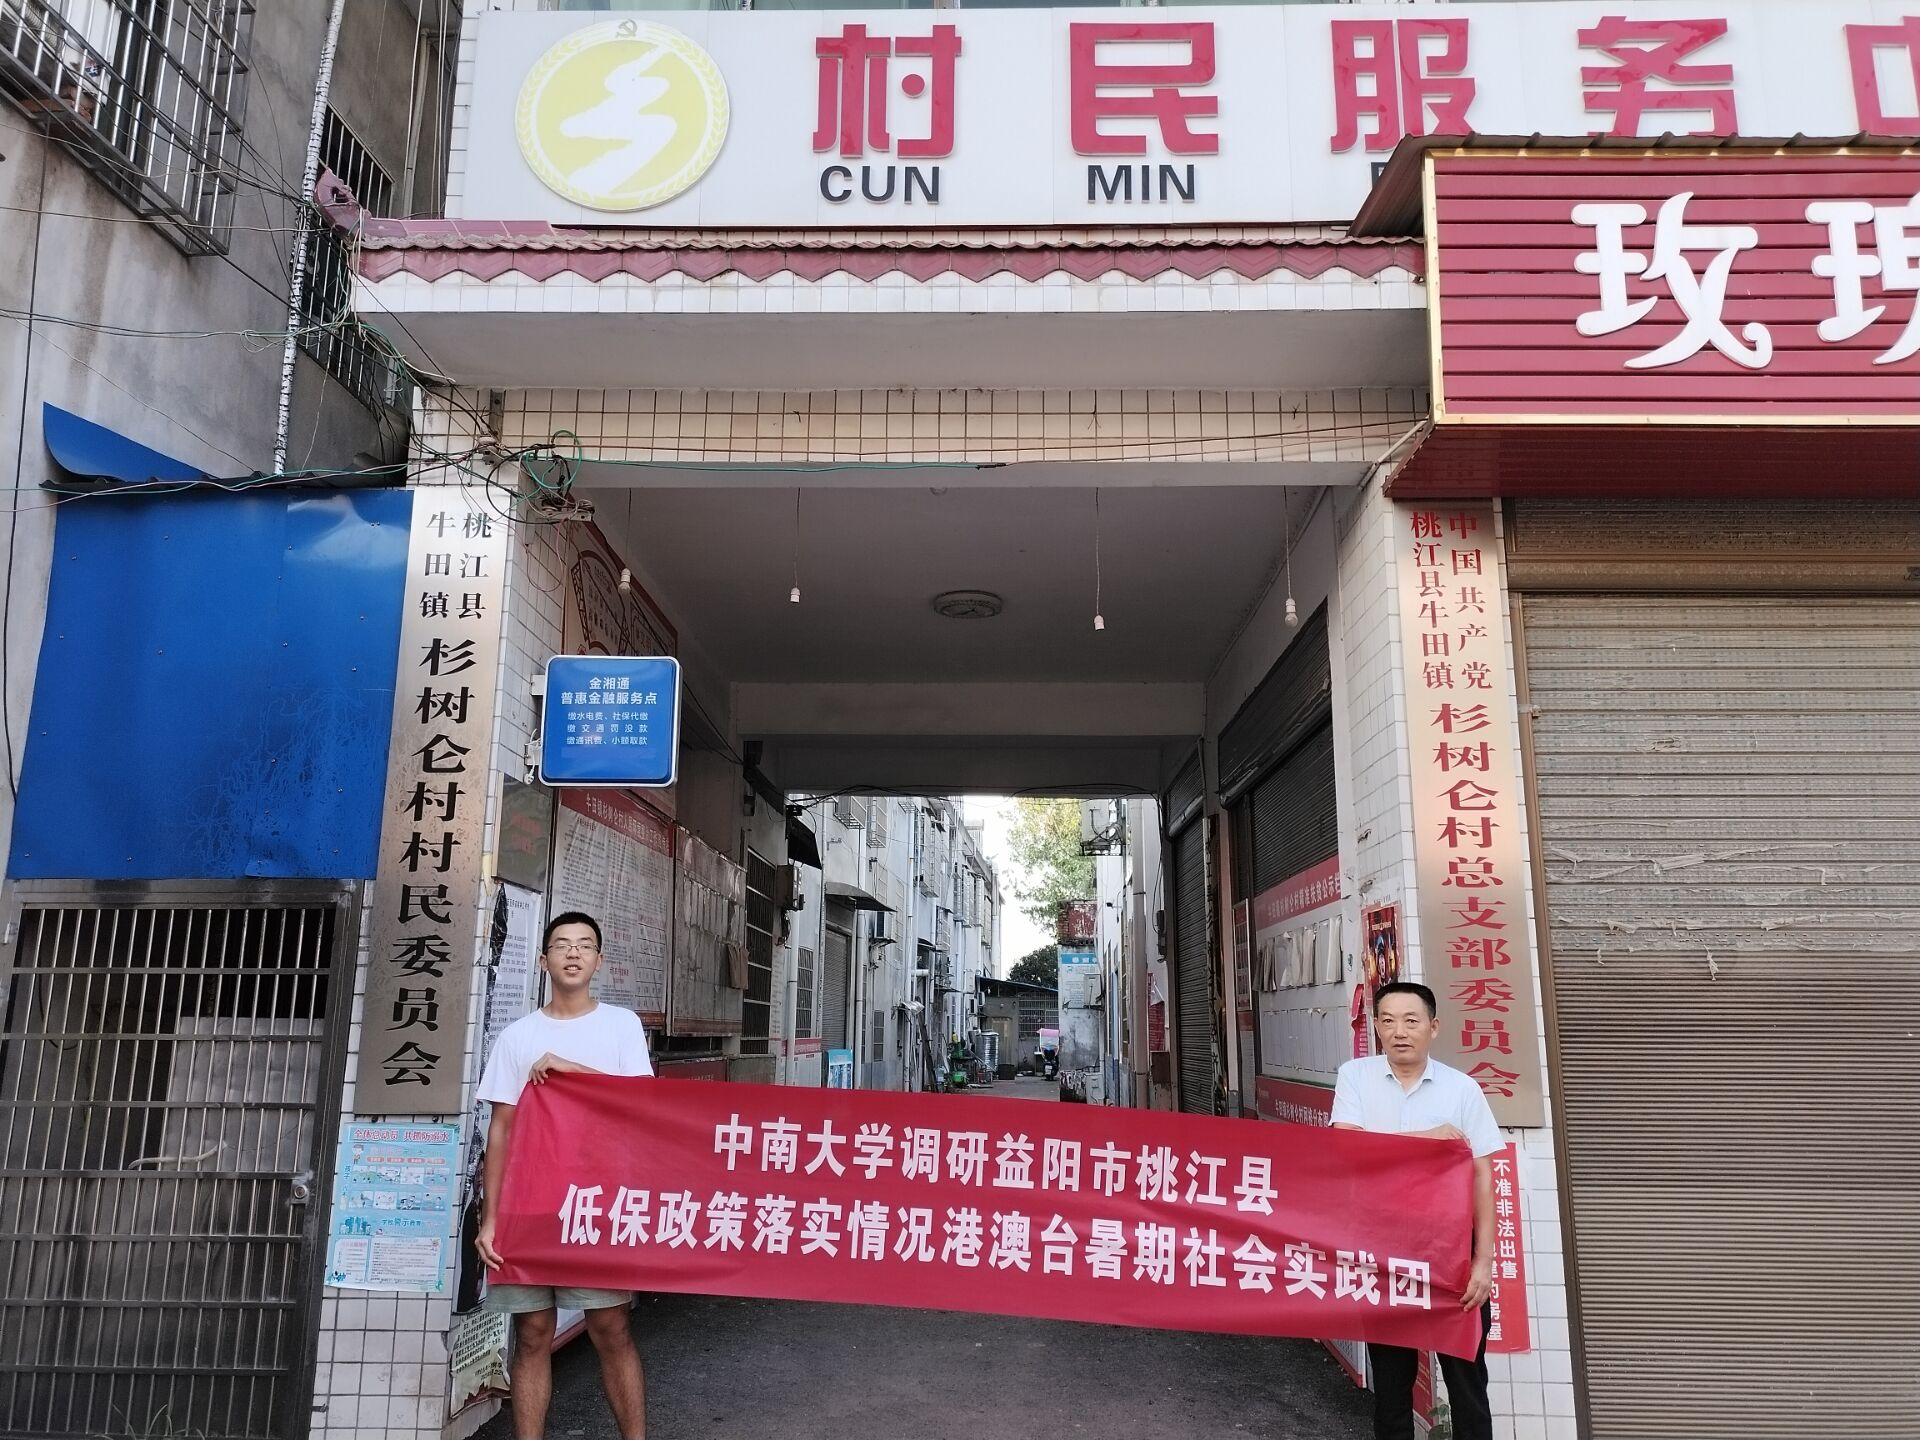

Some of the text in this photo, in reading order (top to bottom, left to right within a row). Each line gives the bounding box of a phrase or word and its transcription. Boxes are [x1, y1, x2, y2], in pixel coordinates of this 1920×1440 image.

[820, 163, 1196, 204] CUN MIN
[419, 511, 456, 619] 牛田镇
[456, 512, 493, 620] 桃江县
[1410, 511, 1454, 690] 桃江县牛田镇
[1449, 511, 1493, 690] 中国共产党
[561, 691, 658, 705] 普惠金融服务点
[589, 677, 630, 690] 金湘通
[381, 637, 476, 1087] 杉树仑村村民委员会
[1430, 702, 1521, 1098] 杉树仑村总支部委员会
[713, 1113, 1280, 1217] 中南大学调研益阳市桃江县
[1493, 1159, 1518, 1280] 不准非法出售
[557, 1183, 1433, 1311] 低保政策落实情况港澳台暑期社会实践团
